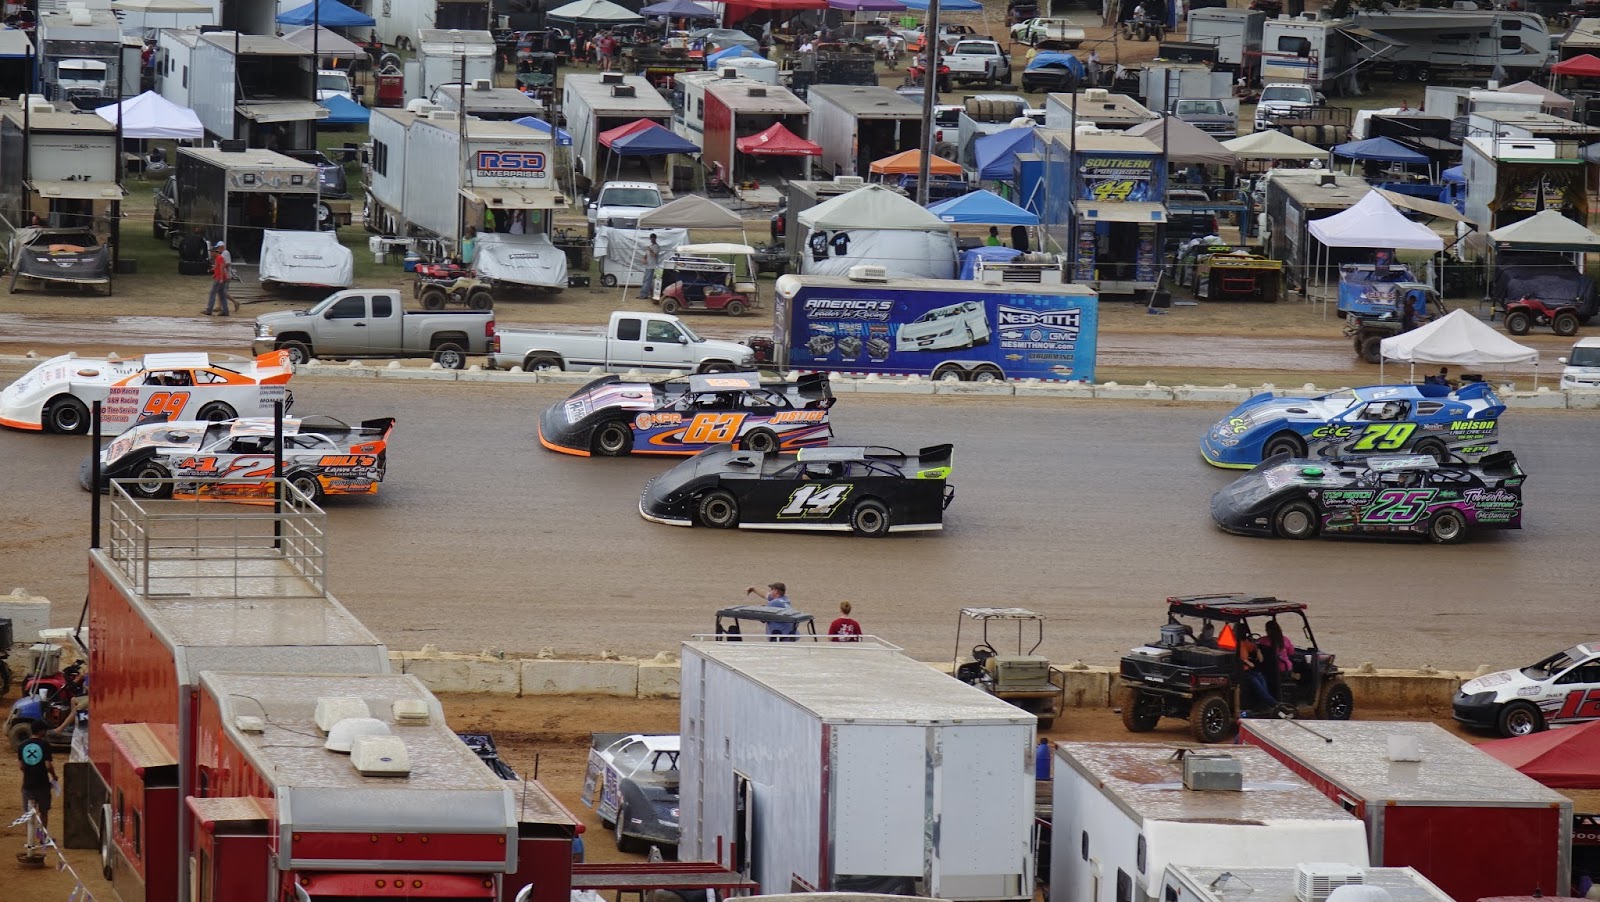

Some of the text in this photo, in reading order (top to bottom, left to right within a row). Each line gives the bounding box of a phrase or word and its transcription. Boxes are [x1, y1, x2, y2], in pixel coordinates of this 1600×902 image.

[478, 152, 545, 170] RSD
[1085, 158, 1152, 168] SOUTHERN
[1094, 180, 1136, 200] 44
[806, 300, 892, 310] AMERICA'S
[853, 310, 889, 320] Racing
[1002, 342, 1074, 350] NESMITHNOW.com
[137, 392, 190, 422] 99
[651, 413, 682, 424] KPR
[768, 411, 827, 424] JUSTICE
[1451, 420, 1495, 430] Nelson
[682, 413, 748, 443] 63
[1353, 423, 1417, 450] 79
[178, 456, 218, 472] A-1
[216, 454, 288, 489] 2
[780, 485, 851, 516] 14
[1362, 490, 1438, 524] 25
